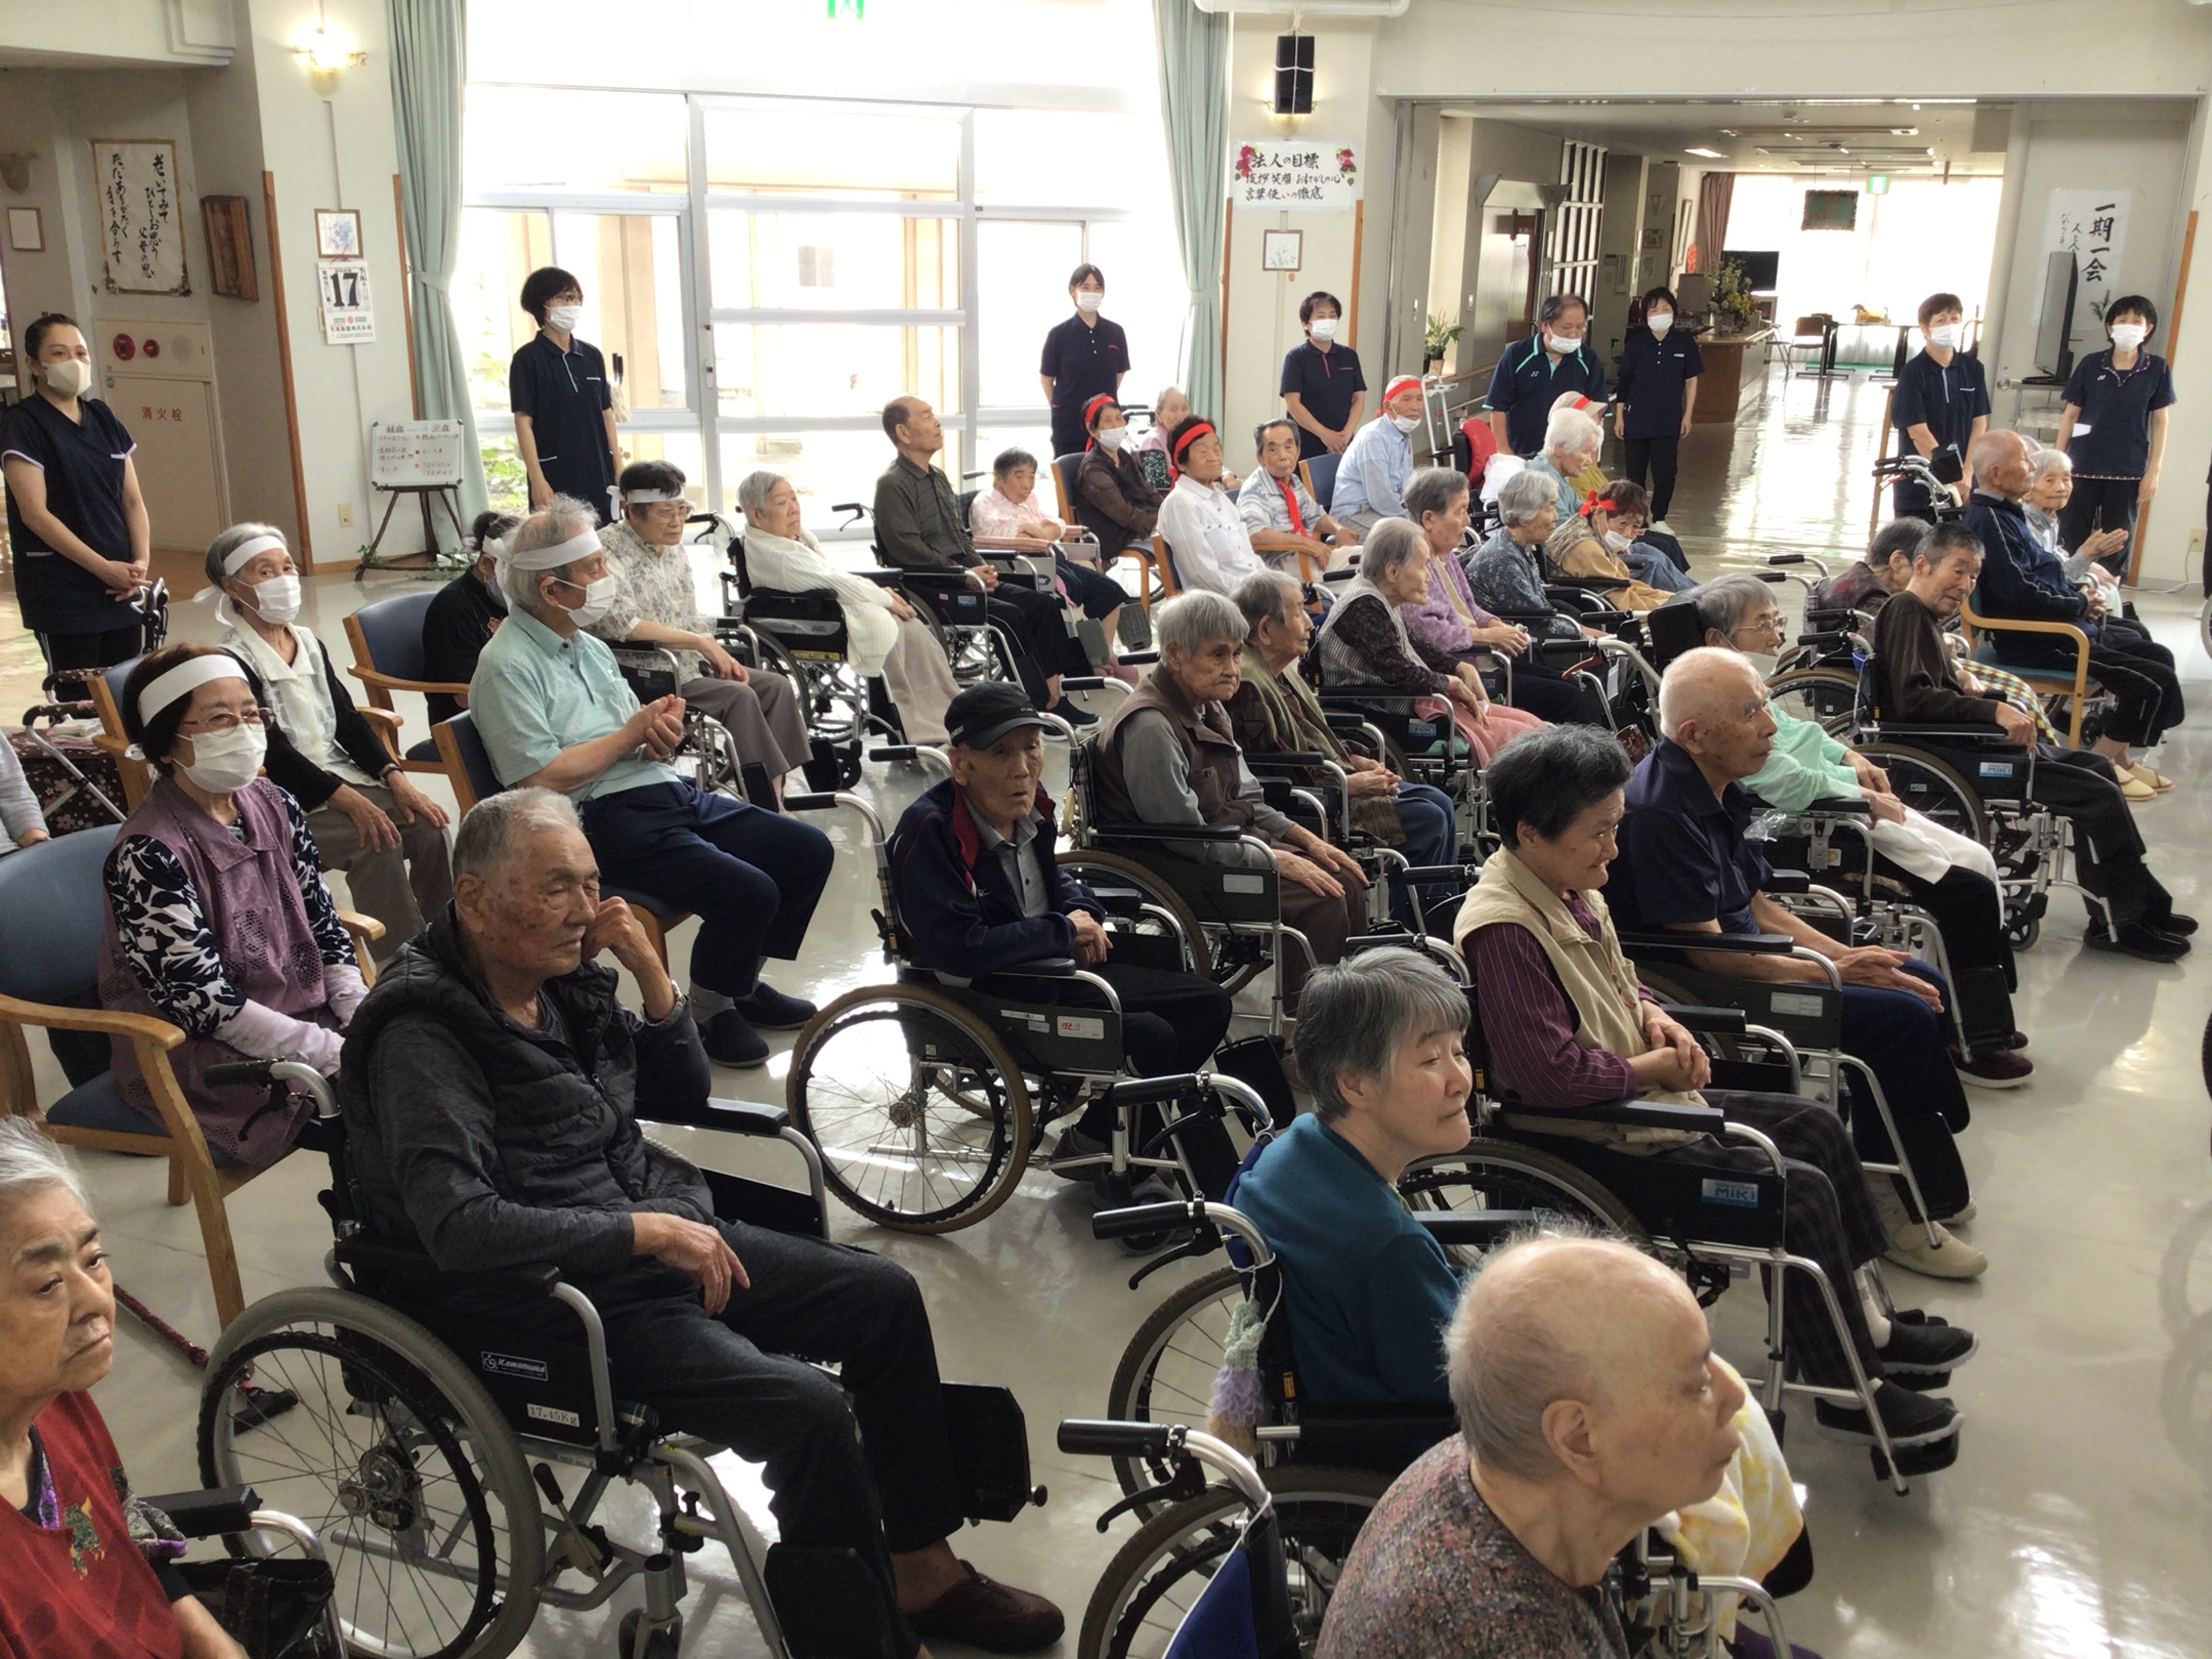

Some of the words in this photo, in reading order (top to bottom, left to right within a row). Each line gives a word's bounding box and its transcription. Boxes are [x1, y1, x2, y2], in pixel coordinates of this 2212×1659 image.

[1252, 152, 1319, 169] 法人の目標
[112, 153, 129, 238] ただありがたく
[152, 153, 169, 224] 老いてみて
[1246, 185, 1324, 201] 言葉使いの徹底
[2082, 203, 2116, 282] 一期一会
[330, 272, 360, 307] 17
[142, 407, 182, 422] 消火栓
[1715, 1187, 1755, 1200] MIKI
